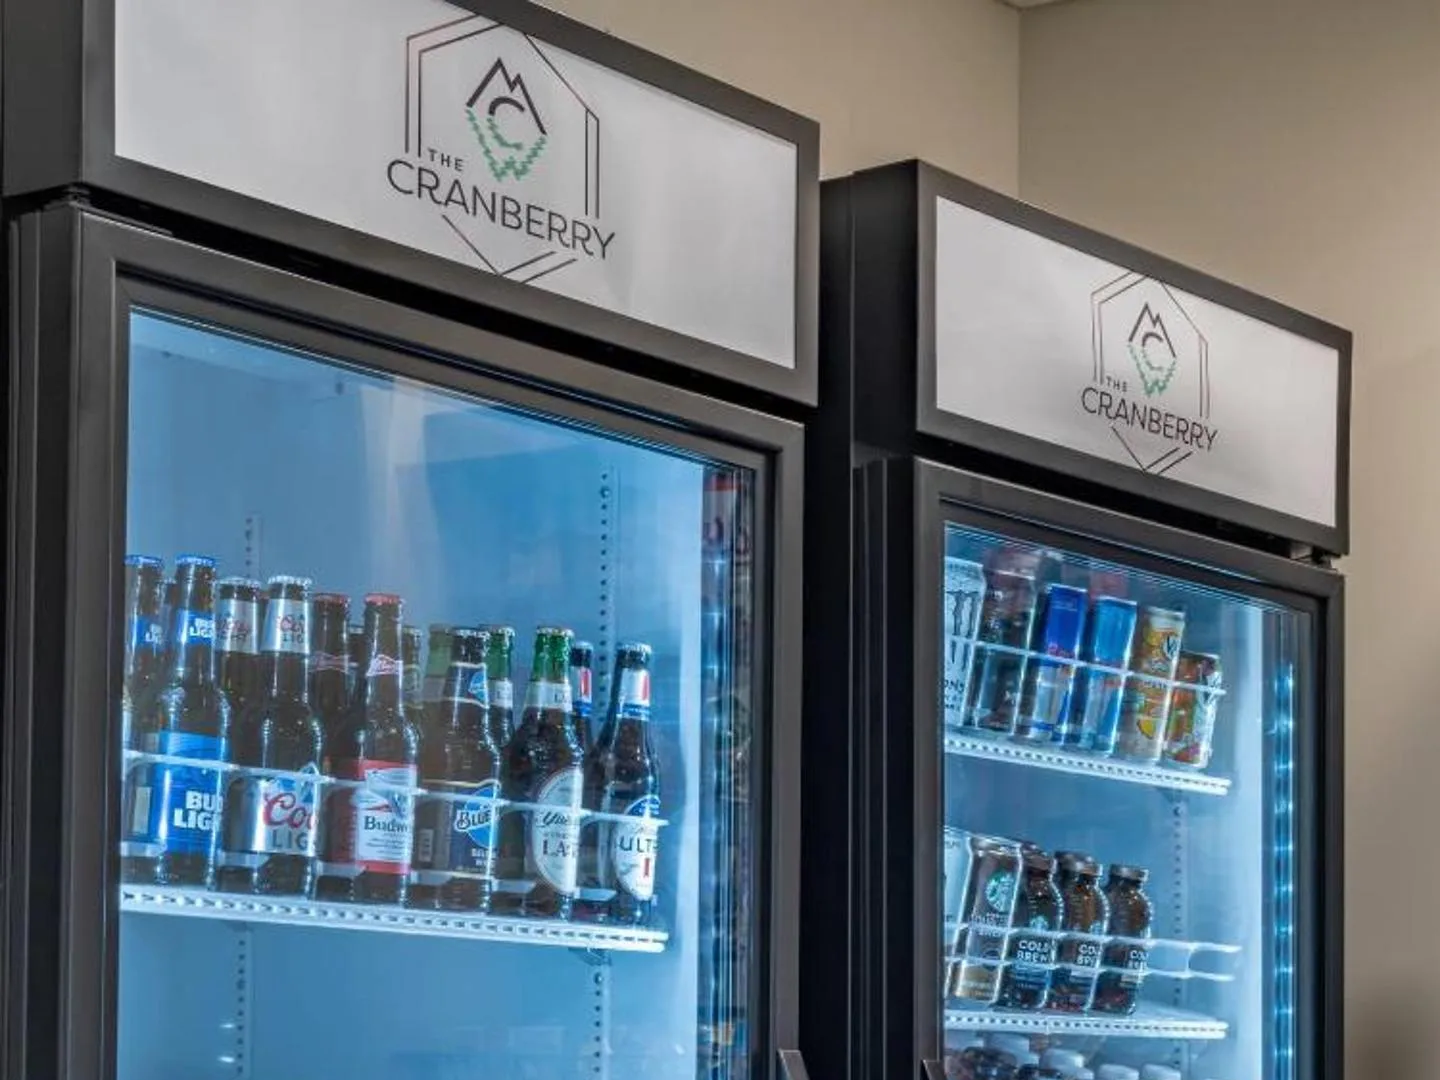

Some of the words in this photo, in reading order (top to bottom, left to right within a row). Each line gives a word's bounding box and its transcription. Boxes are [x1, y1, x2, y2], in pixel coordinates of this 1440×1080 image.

[427, 147, 465, 173] THE
[386, 158, 616, 261] CRANBERRY
[1105, 376, 1128, 392] THE
[1081, 387, 1218, 452] CRANBERRY
[174, 808, 222, 831] LIG
[263, 792, 318, 829] Coo
[272, 829, 311, 850] LIG
[615, 835, 655, 854] ULT
